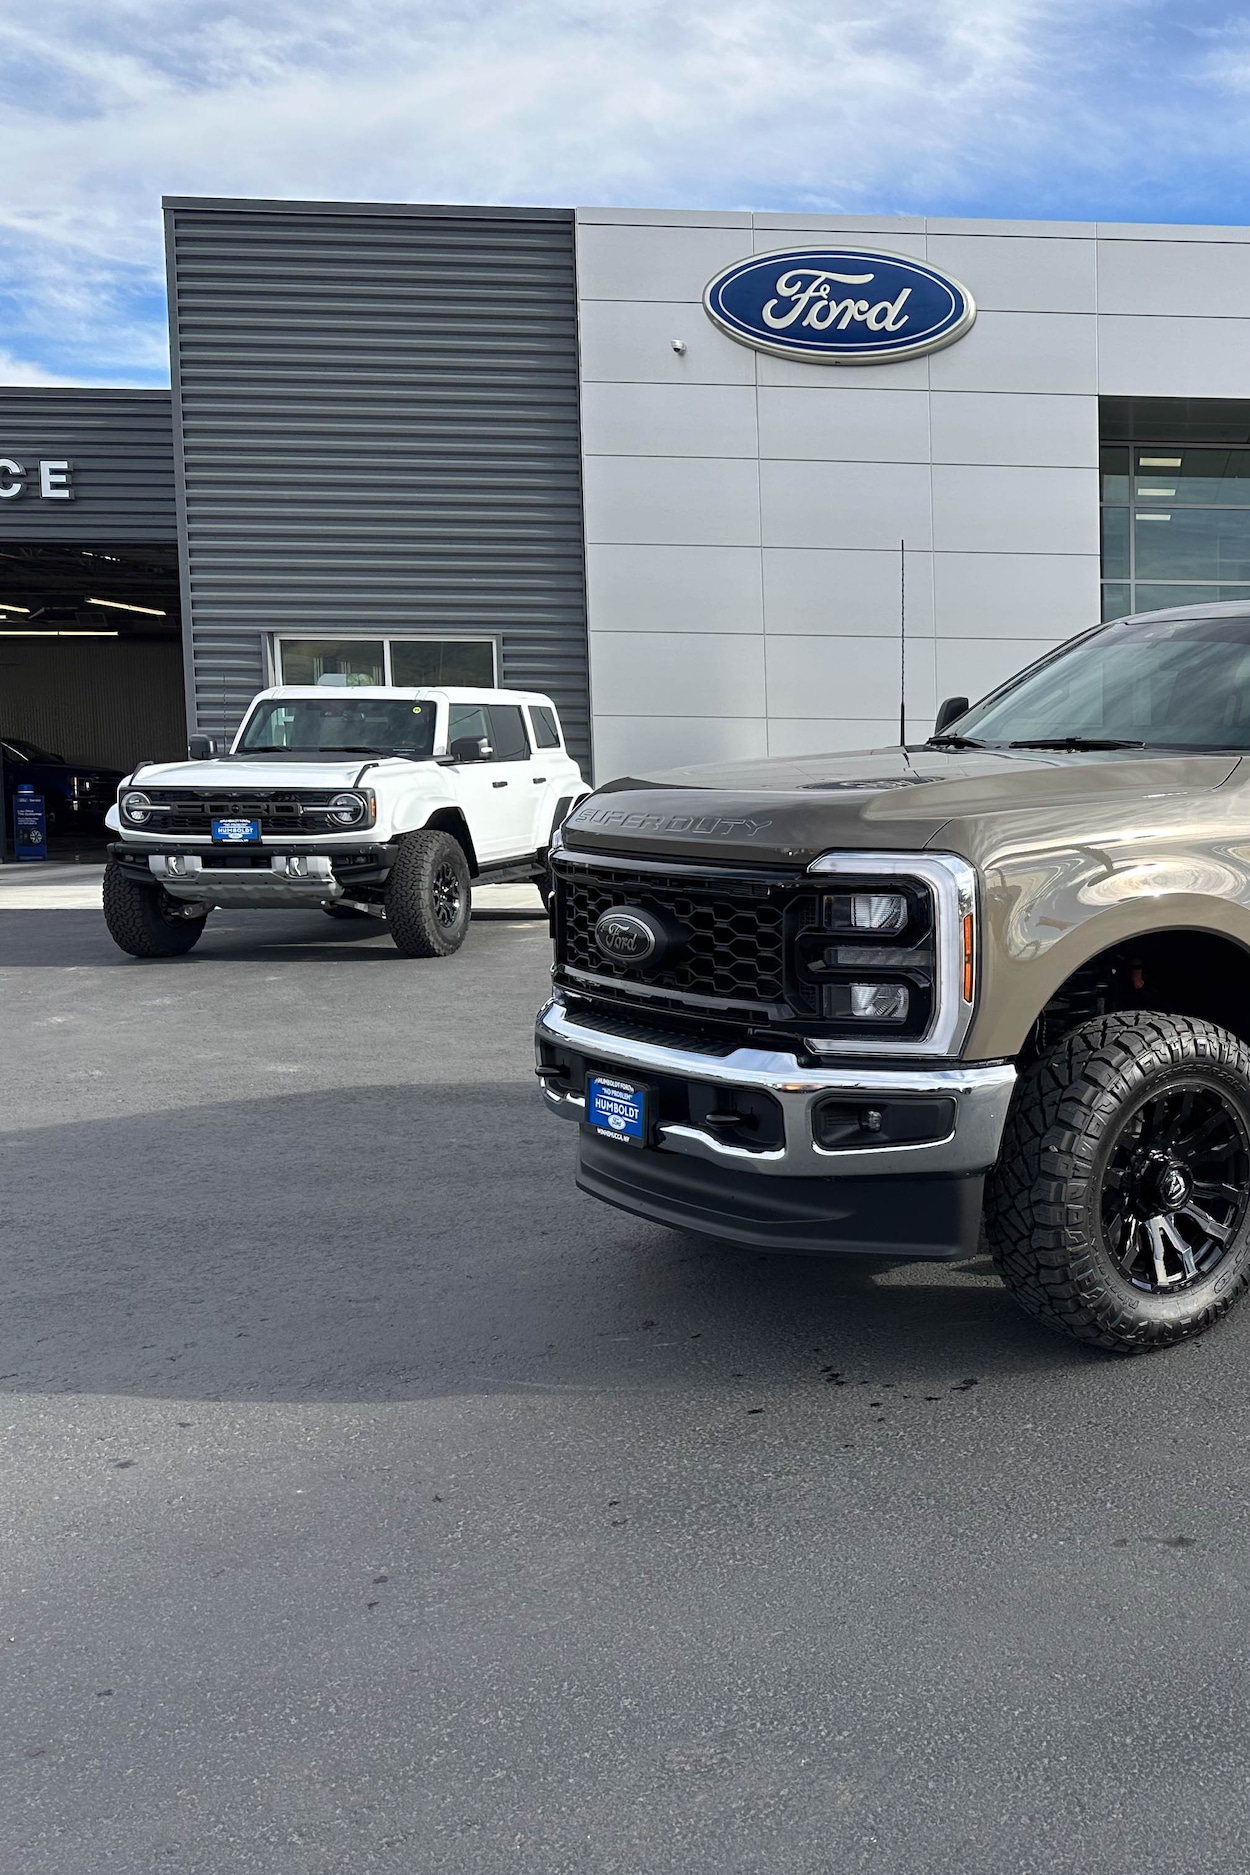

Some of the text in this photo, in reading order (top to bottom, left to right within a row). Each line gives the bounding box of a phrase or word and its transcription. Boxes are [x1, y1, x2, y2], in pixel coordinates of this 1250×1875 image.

[762, 269, 912, 332] Ford
[0, 458, 73, 499] CE
[575, 808, 773, 837] SUPER DUTY
[606, 922, 638, 952] Ford
[595, 1097, 639, 1119] HUMBOLDT
